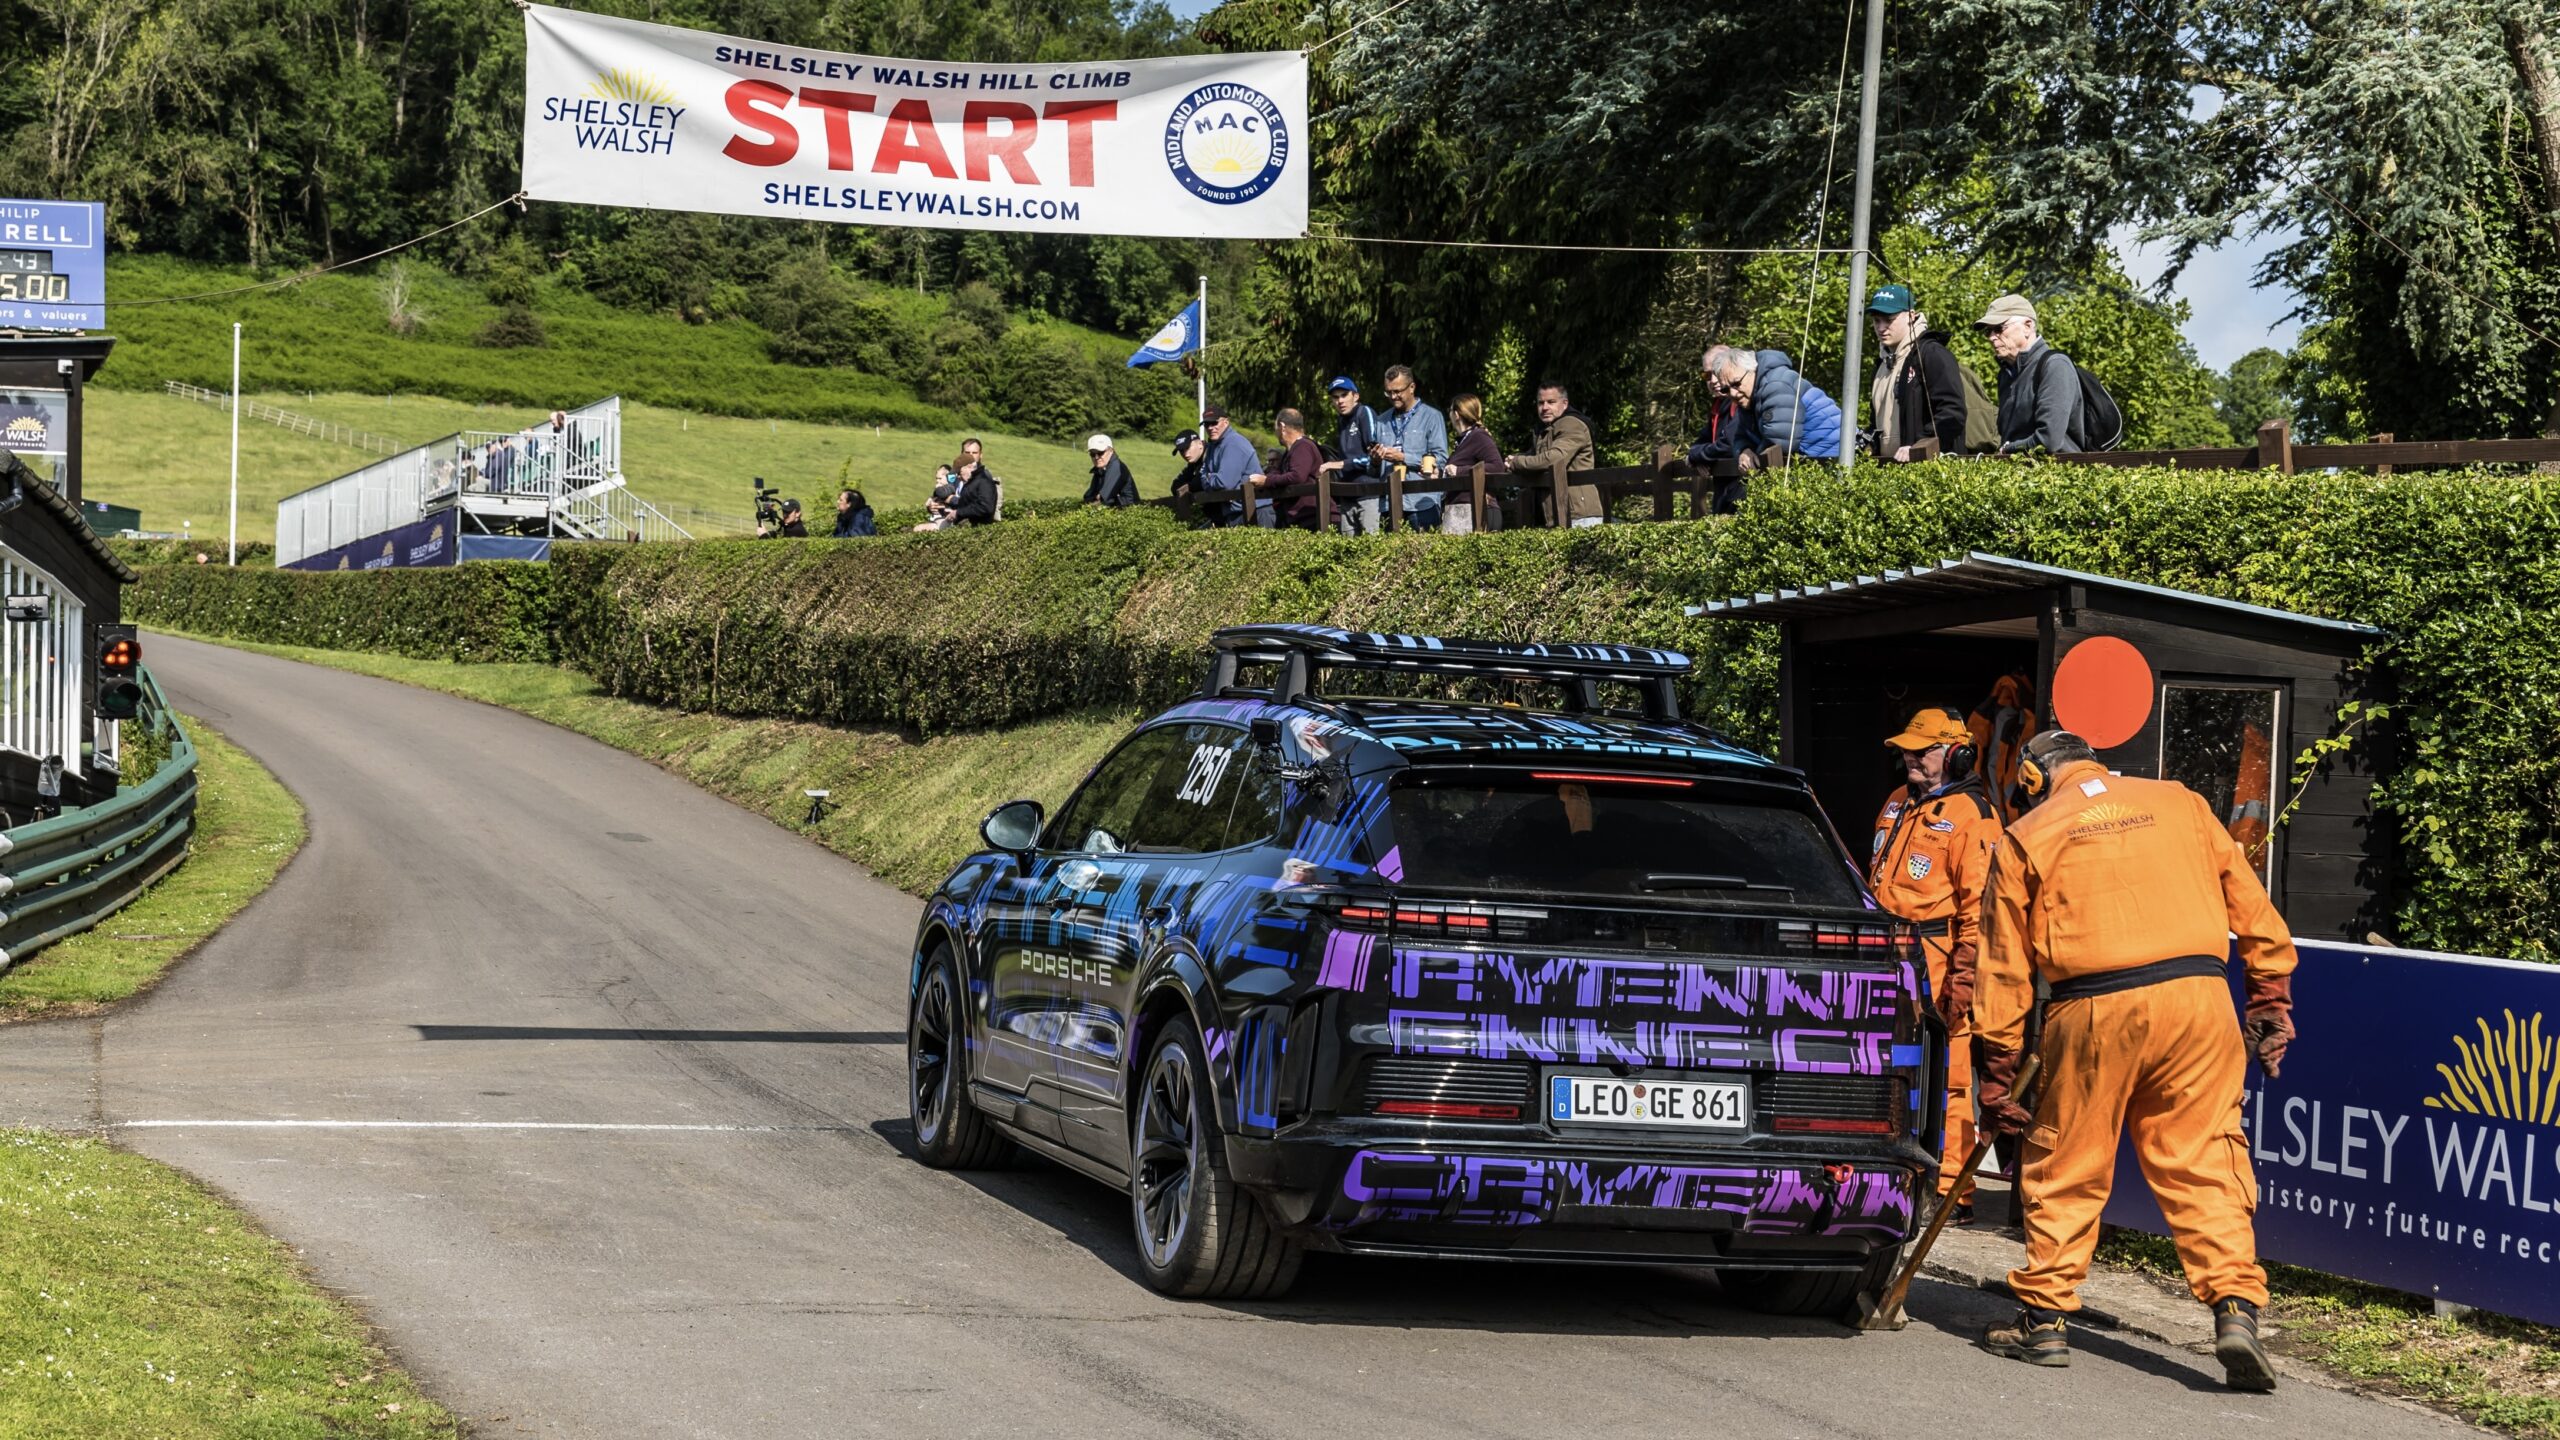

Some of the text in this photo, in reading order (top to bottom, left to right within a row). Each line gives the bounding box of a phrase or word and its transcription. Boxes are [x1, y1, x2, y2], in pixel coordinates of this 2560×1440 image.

[714, 46, 1131, 90] SHELSLEY WALSH HILL CLIMB
[543, 97, 686, 130] SHELSLEY
[1167, 85, 1286, 170] MIDLAND AUTOMOBILE CLUB
[1194, 112, 1259, 135] MAC
[575, 124, 674, 155] WALSH
[722, 79, 1119, 188] START
[763, 182, 1081, 221] SHELSLEYWALSH.COM
[1197, 184, 1259, 200] FOUNDED 1901
[24, 309, 32, 319] &
[42, 310, 87, 321] valuers
[6, 430, 47, 442] WALSH
[2067, 822, 2116, 837] SHELSLEY
[2117, 814, 2155, 828] WALSH
[1021, 948, 1112, 987] PORSCHE
[1558, 1083, 1741, 1122] D LEO GE 861
[2241, 1089, 2560, 1214] LSLEY WAL
[2500, 1233, 2560, 1264] rec
